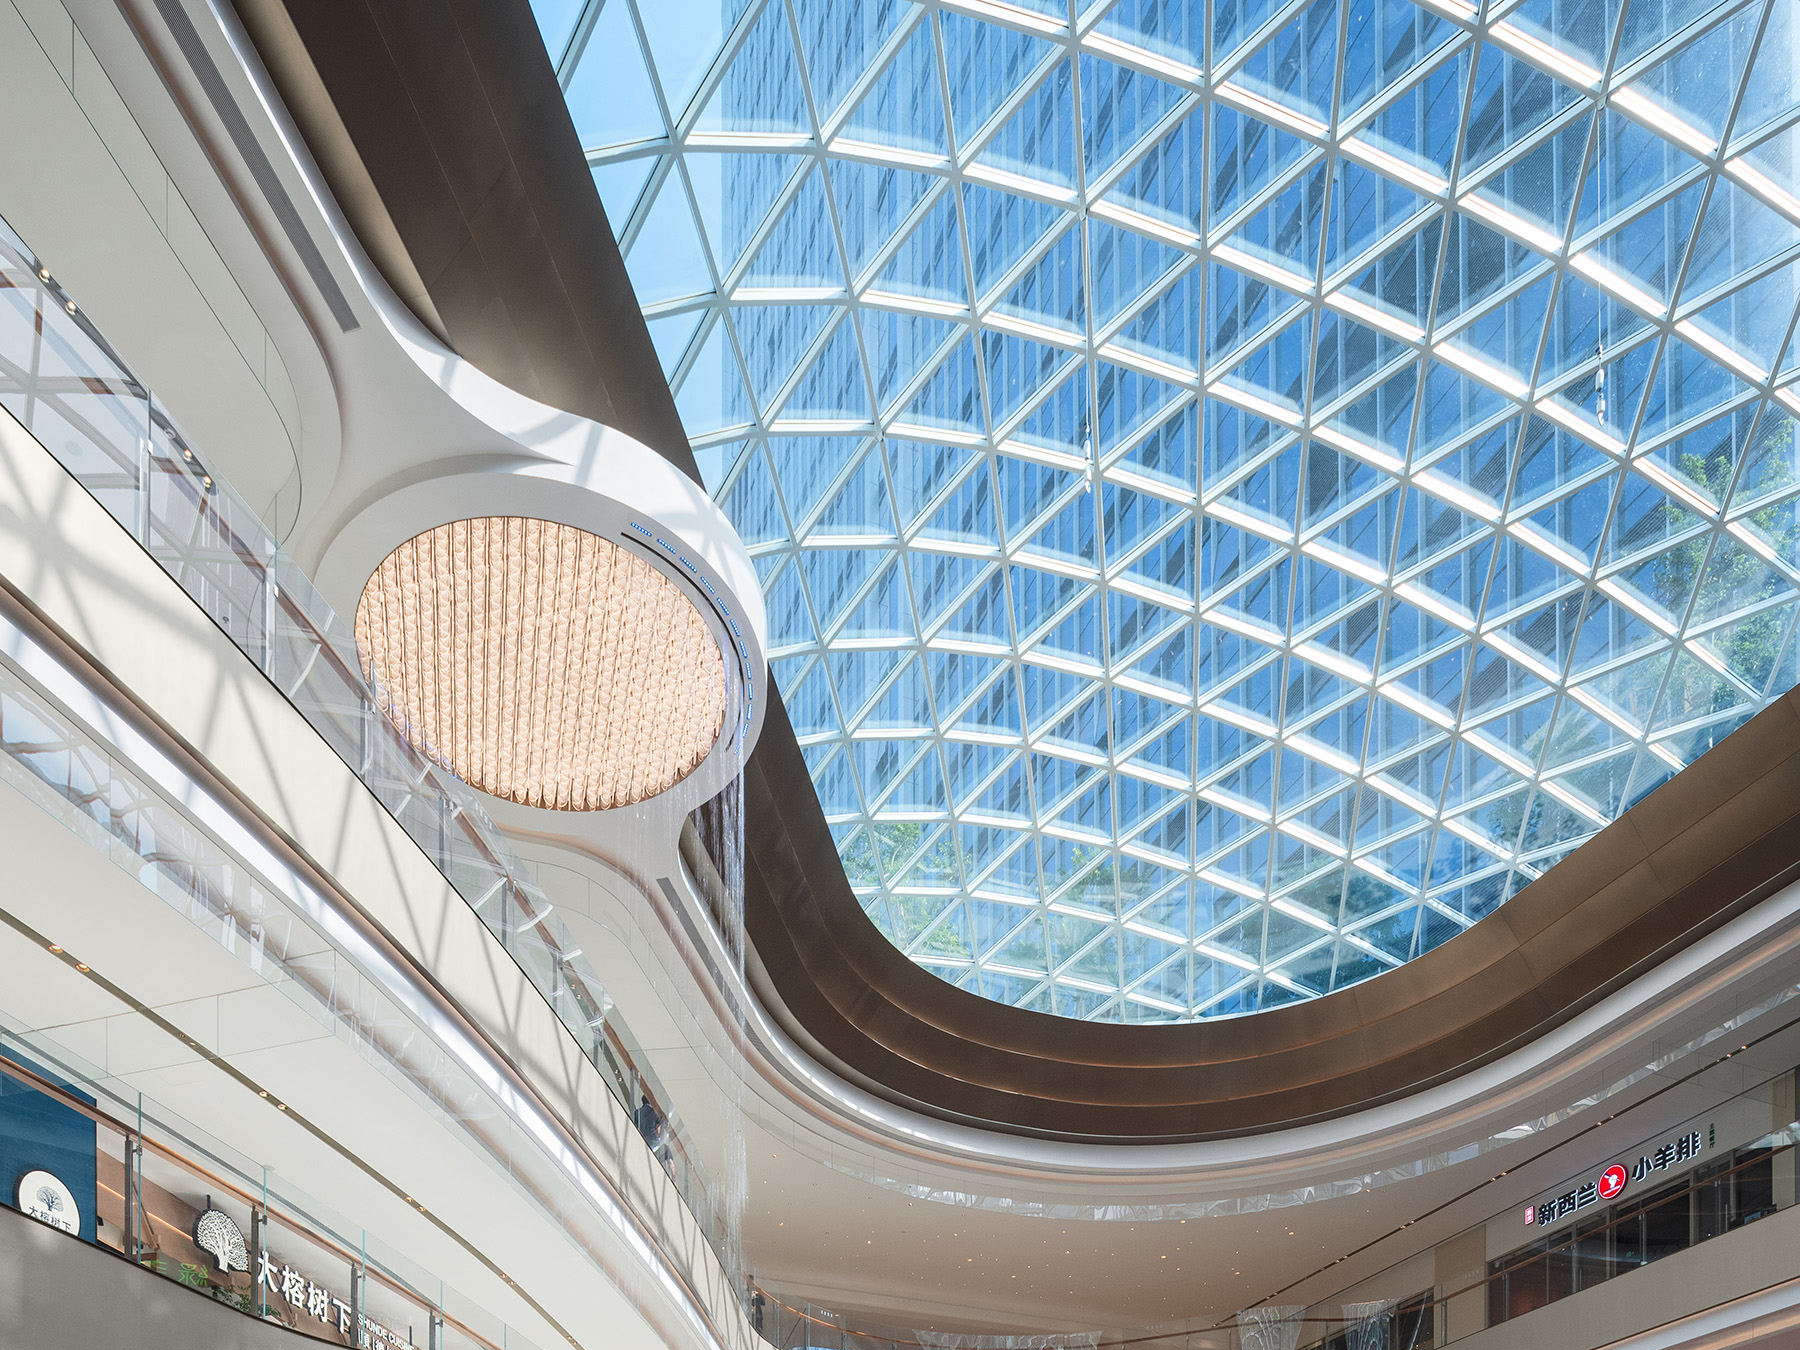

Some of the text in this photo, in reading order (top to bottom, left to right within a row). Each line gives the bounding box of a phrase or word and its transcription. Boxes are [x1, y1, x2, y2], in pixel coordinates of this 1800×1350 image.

[1537, 1181, 1599, 1227] 新西兰
[1631, 1131, 1702, 1182] 小羊排
[257, 1251, 351, 1334] 大榕树下
[358, 1313, 388, 1341] SHUNDE
